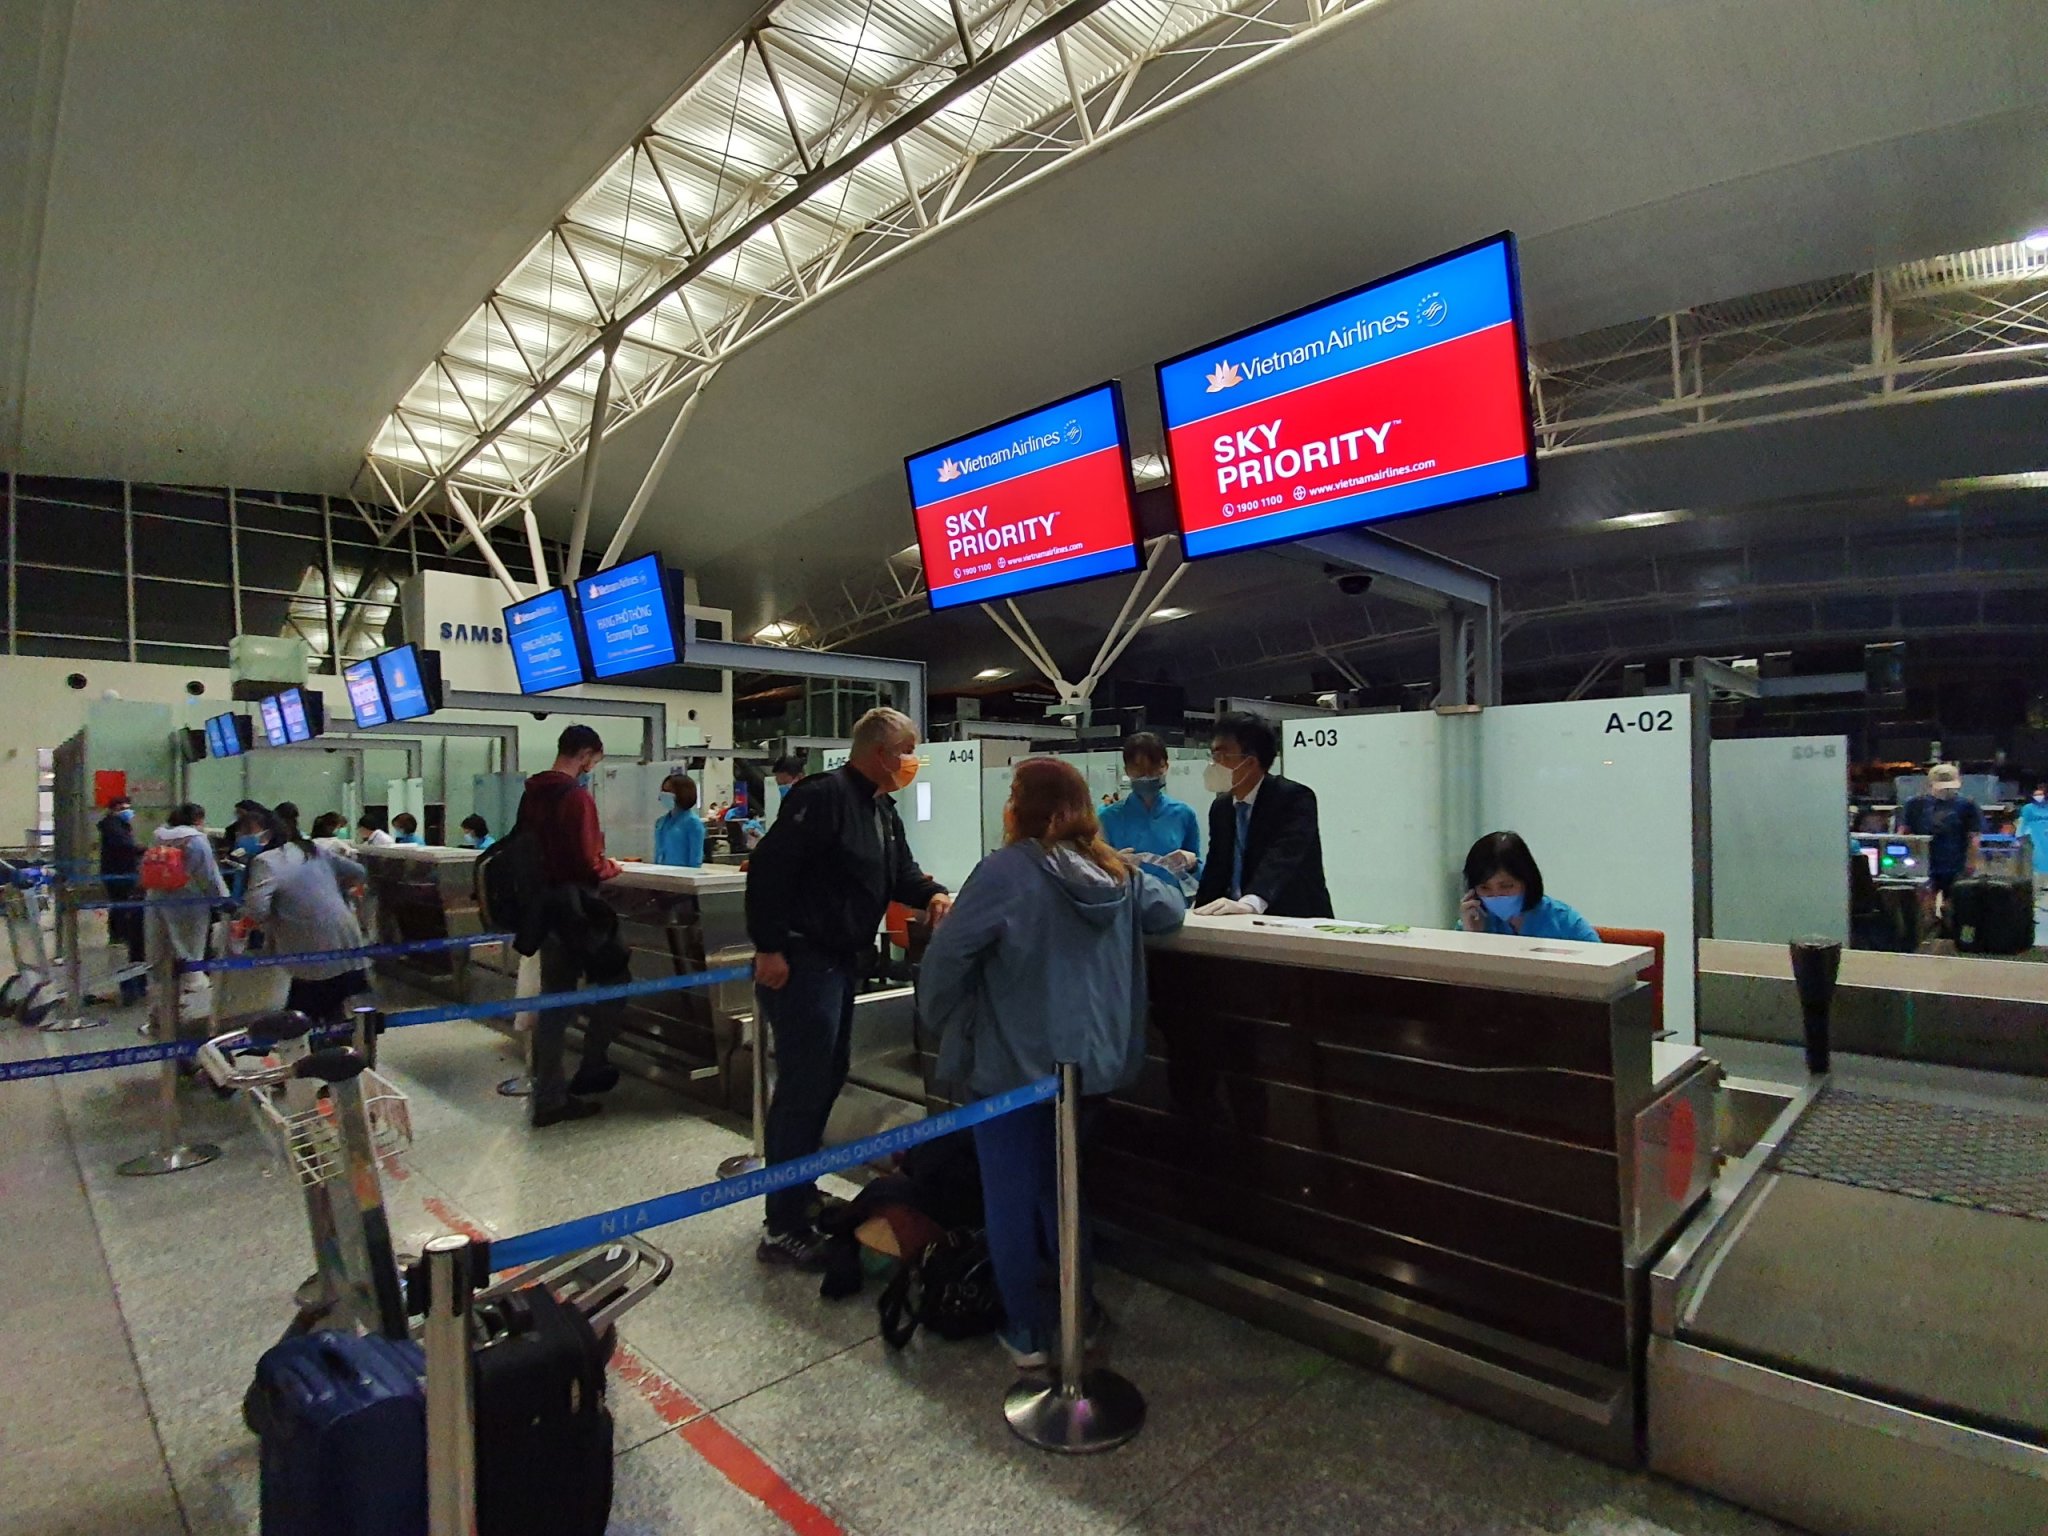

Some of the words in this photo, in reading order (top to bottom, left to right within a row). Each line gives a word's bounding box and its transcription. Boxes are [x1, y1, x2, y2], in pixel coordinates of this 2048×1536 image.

[1241, 341, 1325, 380] Vietnam
[1326, 309, 1410, 353] Airlines
[959, 448, 1011, 475] Vietnam
[1011, 431, 1060, 459] Airlines
[1214, 419, 1282, 463] SKY
[1217, 421, 1392, 494] PRIORITY
[1236, 501, 1259, 513] 1900
[1261, 494, 1283, 507] 1100
[1309, 458, 1436, 496] www.vietnamairlines.com
[945, 505, 988, 537] SKY
[949, 512, 1055, 560] PRIORITY
[962, 565, 977, 576] 1900
[1007, 542, 1084, 565] www.vietnamairlines.com
[1293, 729, 1338, 748] A-03
[1604, 709, 1673, 734] A-02
[949, 748, 974, 762] A-04
